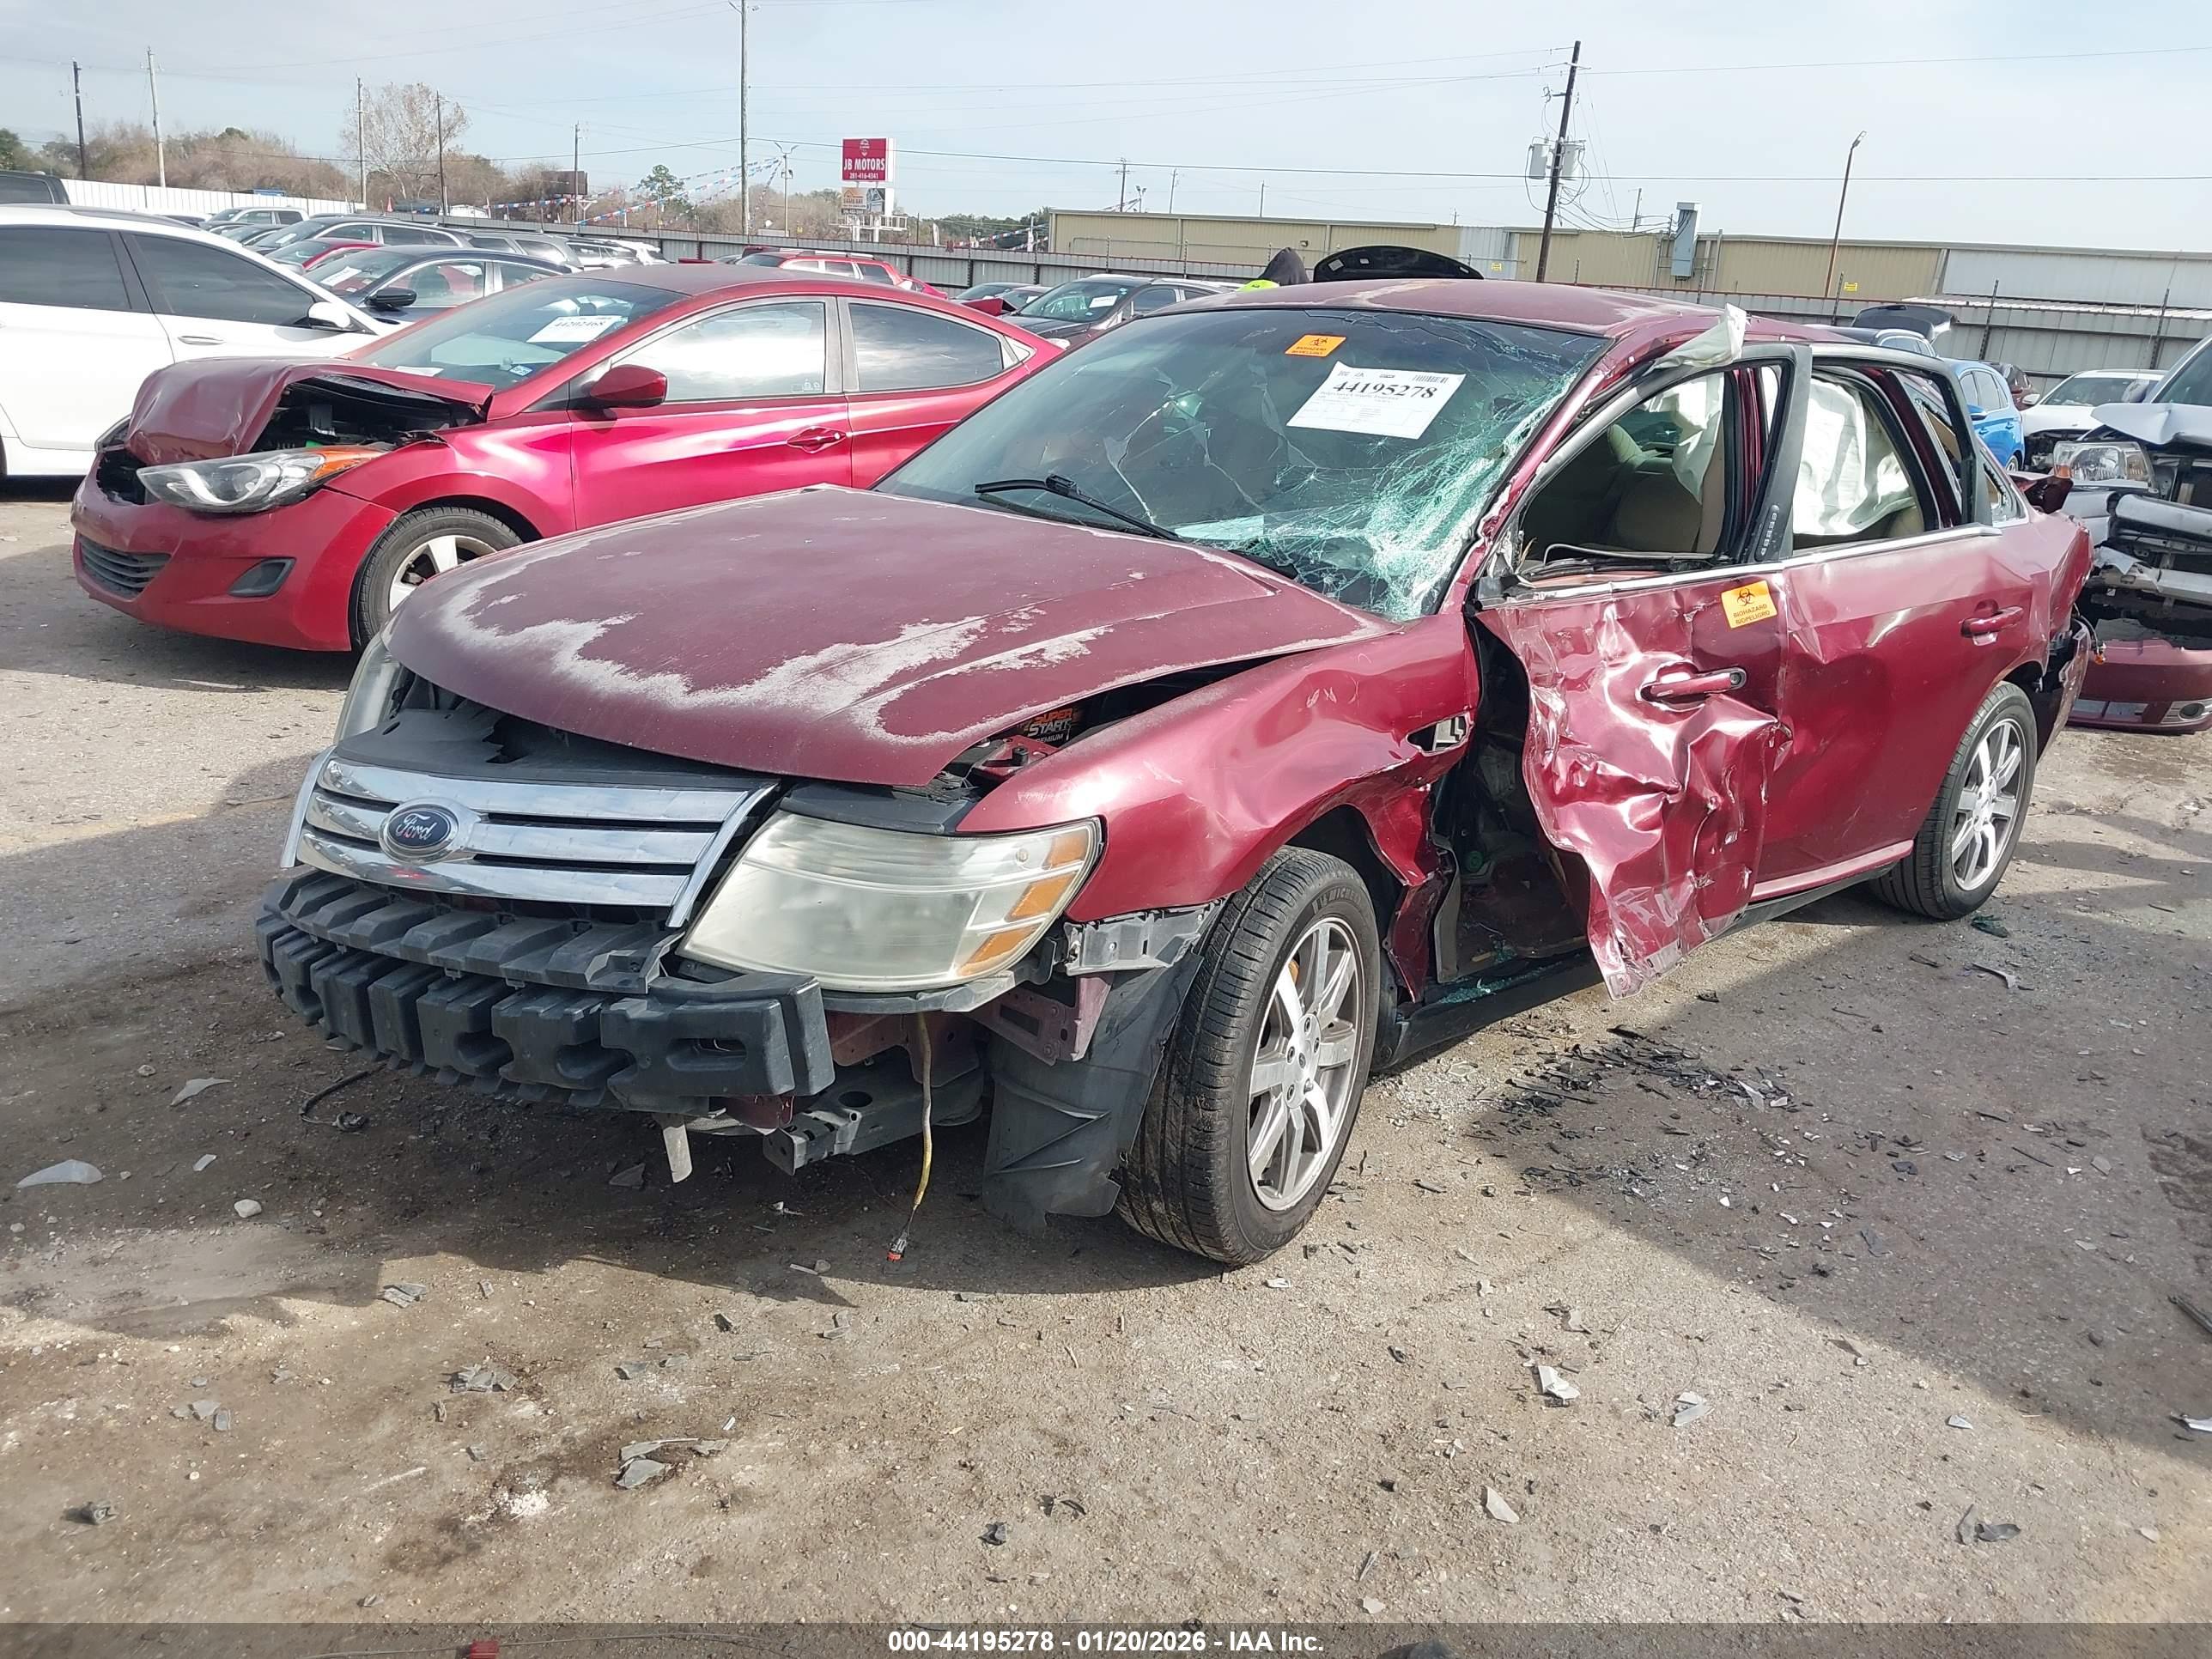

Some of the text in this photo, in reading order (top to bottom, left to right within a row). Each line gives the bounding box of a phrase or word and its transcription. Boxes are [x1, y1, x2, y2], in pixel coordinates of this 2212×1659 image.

[844, 158, 885, 171] JB MOTORS
[1333, 380, 1438, 399] 44195278
[1733, 604, 1767, 618] BIOHAZARD
[1735, 611, 1771, 624] BIOPELIGRO
[1033, 708, 1073, 724] SUPER
[1027, 718, 1072, 737] START
[396, 812, 437, 841] Ford
